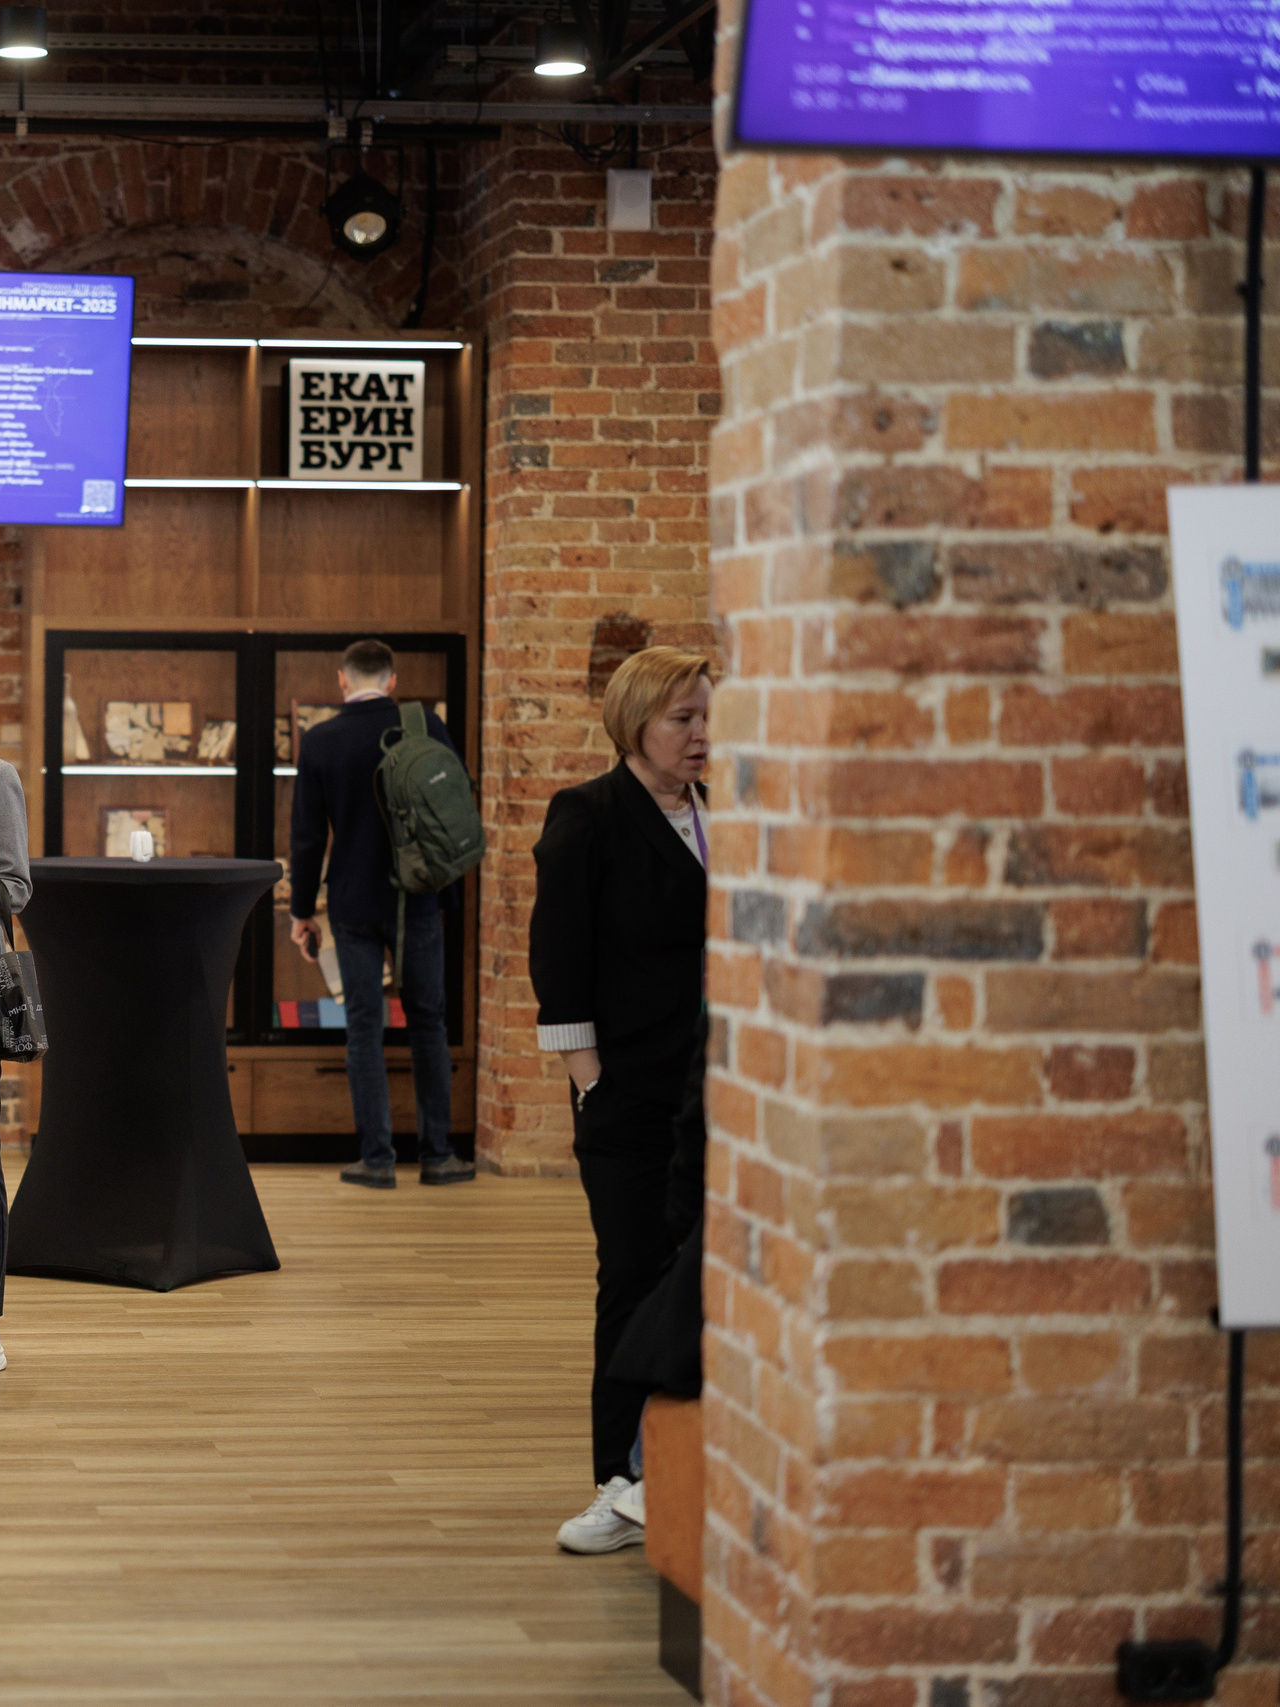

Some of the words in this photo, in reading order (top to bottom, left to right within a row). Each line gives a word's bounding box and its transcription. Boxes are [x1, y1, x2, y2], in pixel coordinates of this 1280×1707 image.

[300, 372, 415, 403] ЕКАТ
[300, 406, 415, 436] ЕРИН
[300, 440, 414, 471] БУРГ
